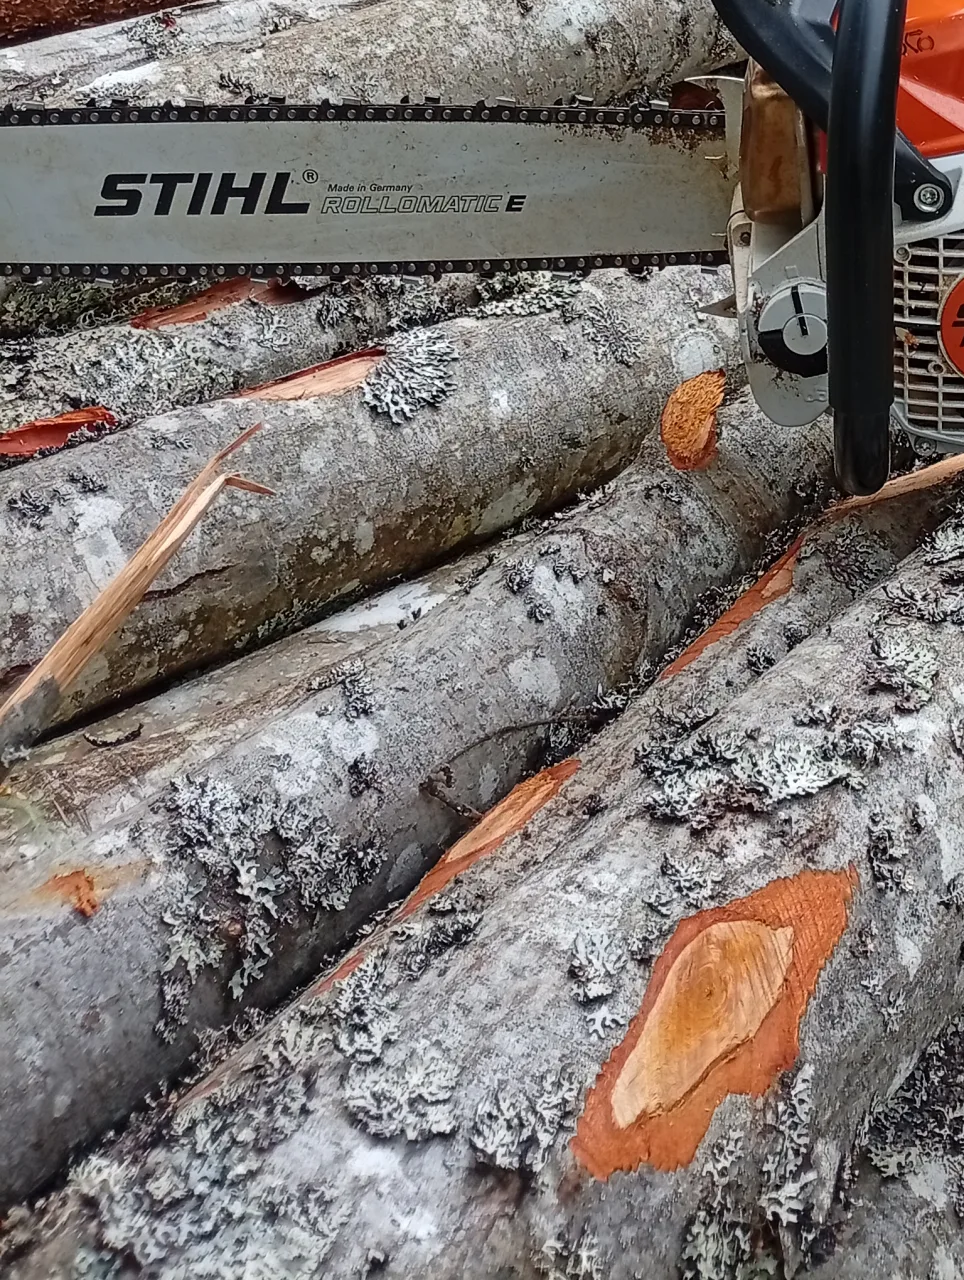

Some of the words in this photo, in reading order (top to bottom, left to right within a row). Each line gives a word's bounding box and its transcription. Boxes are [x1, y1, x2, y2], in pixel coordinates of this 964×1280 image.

[327, 183, 355, 193] Made
[356, 183, 367, 193] in
[369, 184, 414, 194] Germany
[320, 195, 504, 214] ROLLOMATIC
[505, 195, 527, 212] E
